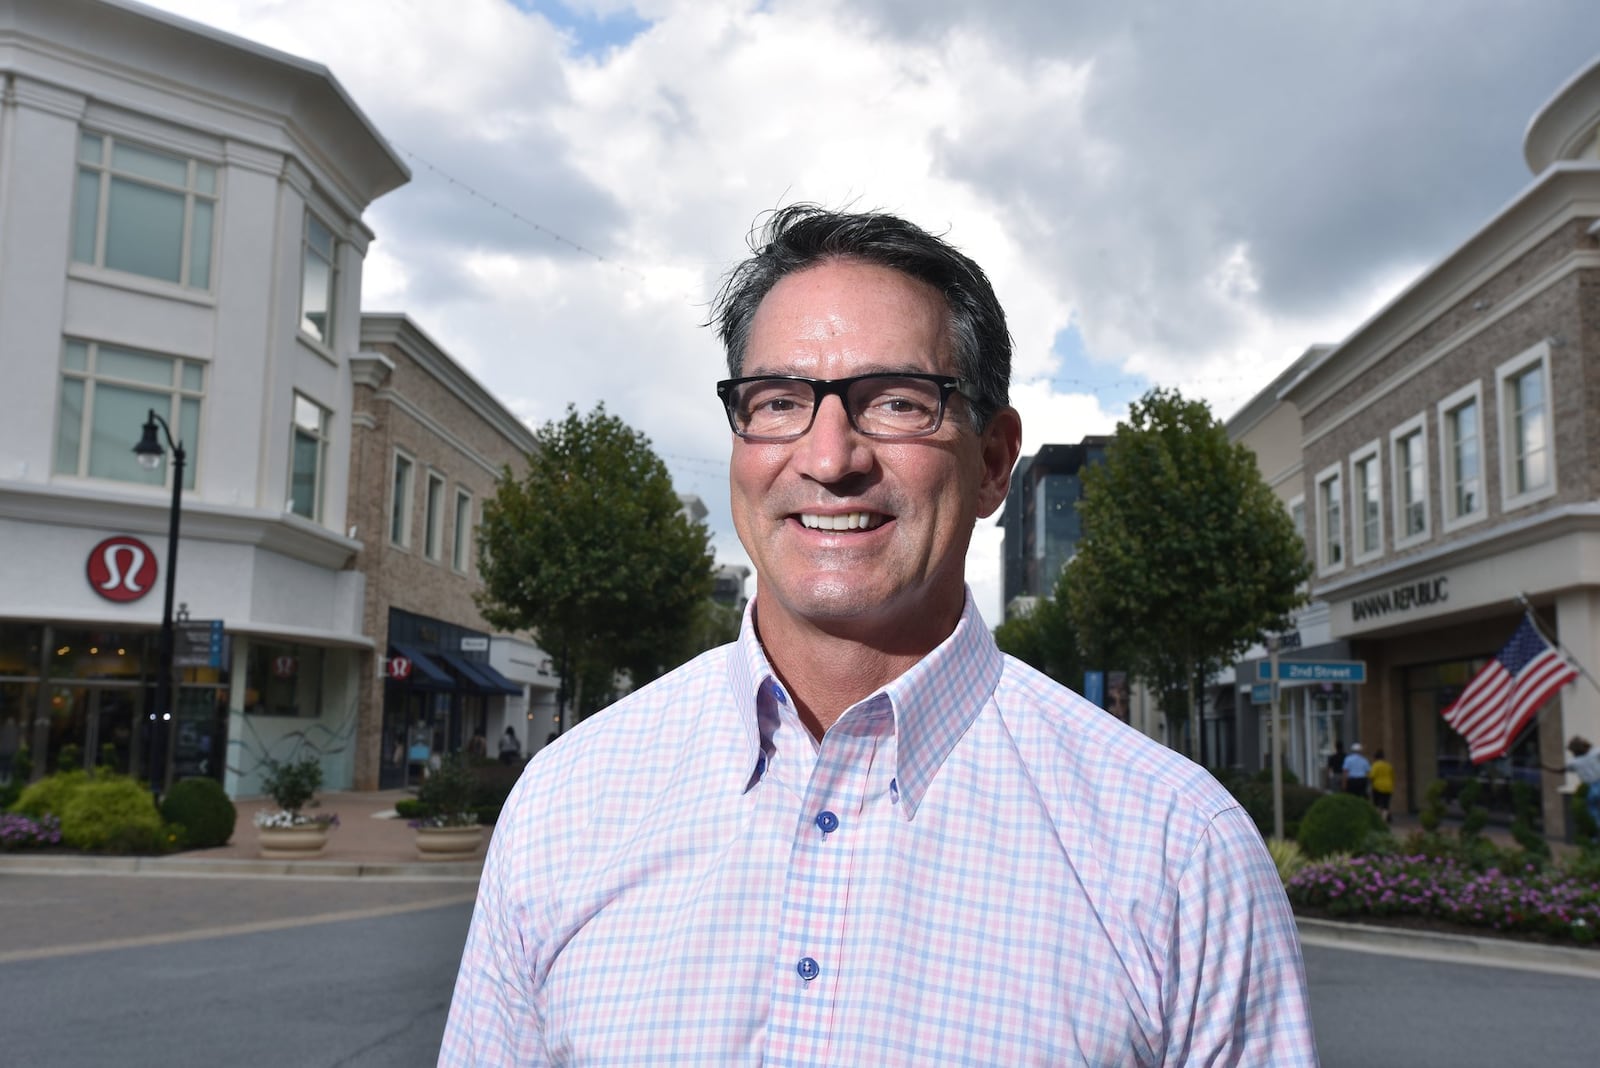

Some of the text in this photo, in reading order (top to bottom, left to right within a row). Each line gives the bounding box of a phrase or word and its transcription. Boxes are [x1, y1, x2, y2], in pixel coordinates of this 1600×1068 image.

[1352, 576, 1448, 621] BANANA REPUBLIC
[1290, 665, 1350, 678] 2nd Street
